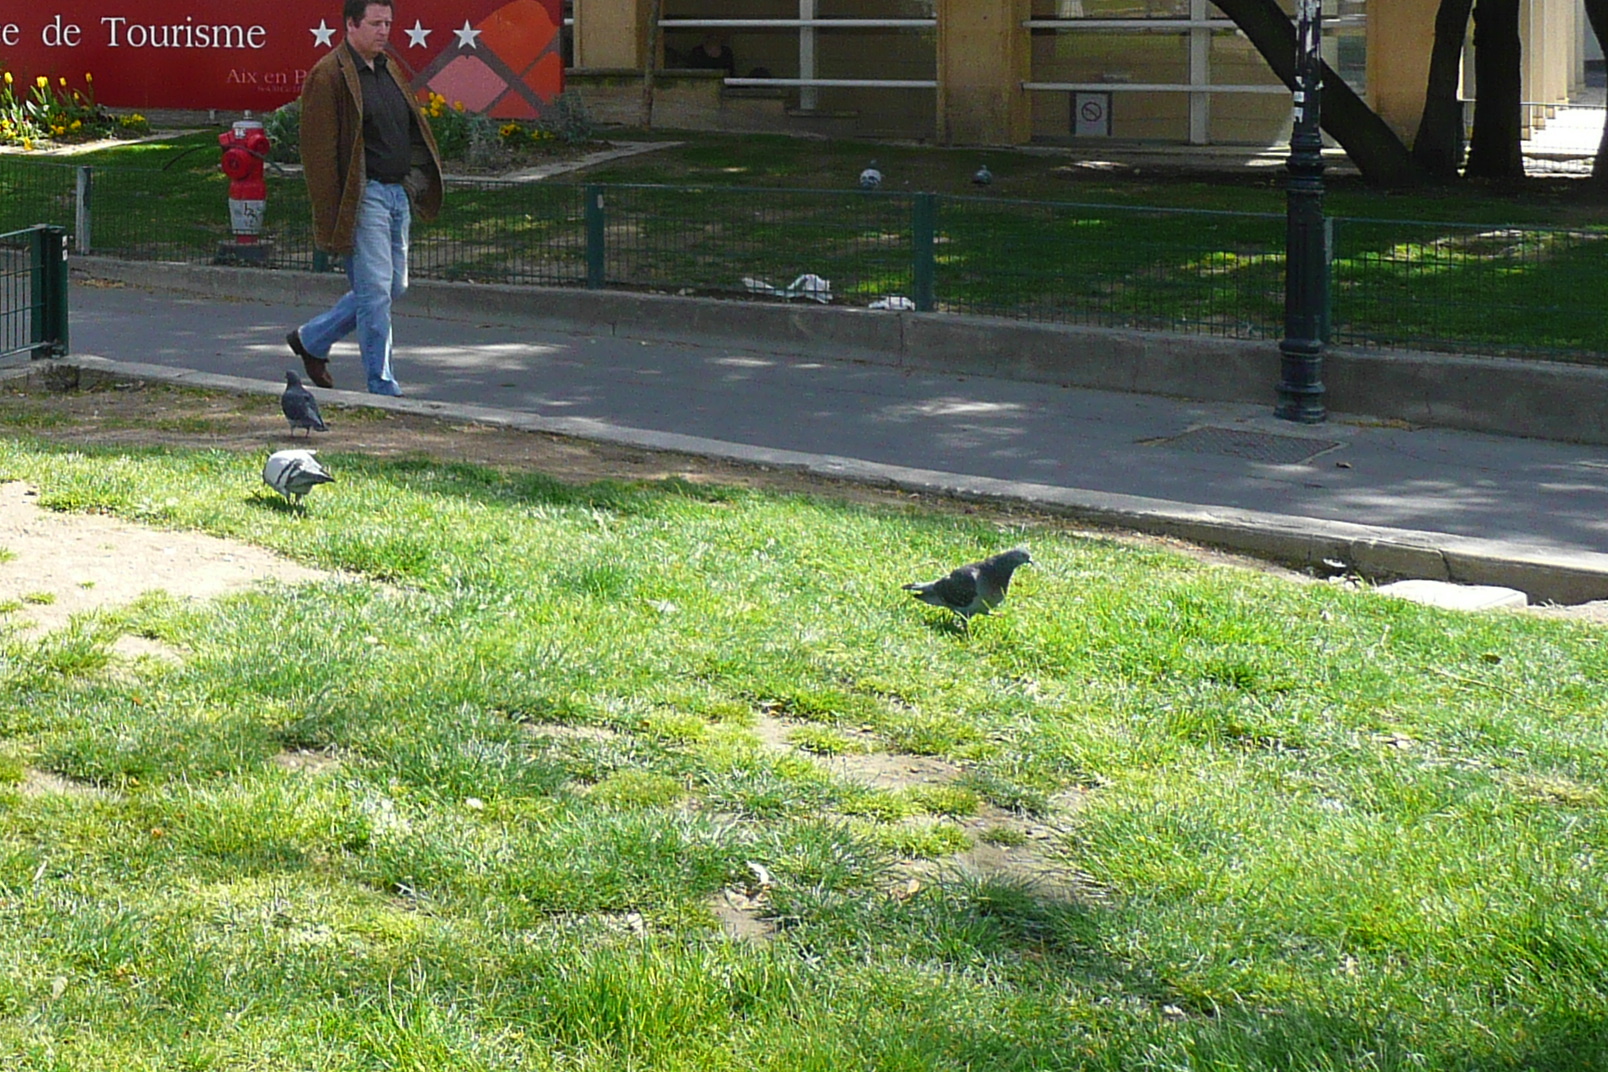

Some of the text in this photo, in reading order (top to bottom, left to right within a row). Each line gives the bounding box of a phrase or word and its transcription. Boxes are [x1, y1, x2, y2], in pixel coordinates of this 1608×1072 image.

[41, 14, 82, 47] de
[100, 15, 267, 49] Tourisme
[226, 68, 258, 84] Aix
[263, 71, 288, 84] en
